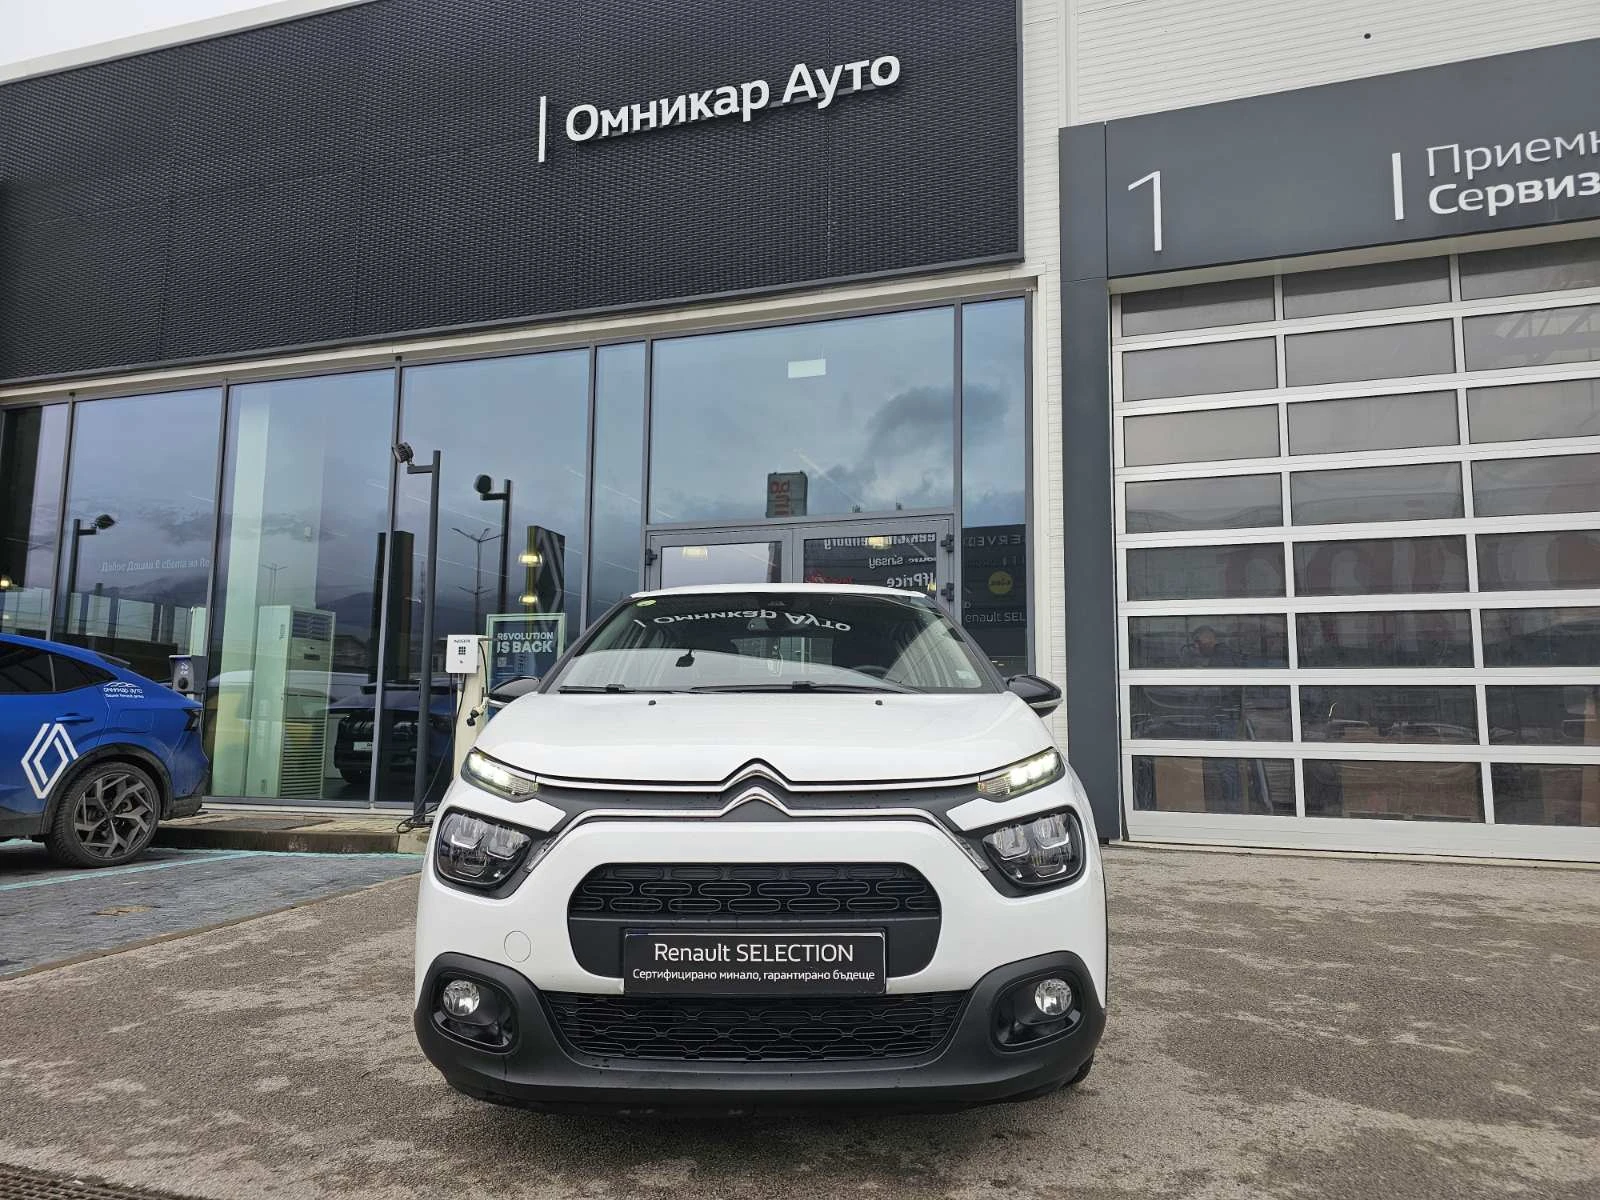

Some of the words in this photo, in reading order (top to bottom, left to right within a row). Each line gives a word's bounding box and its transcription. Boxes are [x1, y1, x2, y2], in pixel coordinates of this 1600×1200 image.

[565, 79, 770, 142] Омникар
[782, 55, 901, 109] Ауто
[1128, 170, 1162, 252] 1
[513, 640, 552, 653] BACK
[654, 943, 731, 962] Renault
[736, 944, 854, 963] SELECTION
[633, 968, 717, 981] Сертифицирано
[719, 971, 762, 981] минало,
[763, 971, 831, 981] гарантирано
[833, 969, 875, 981] бъдеще
